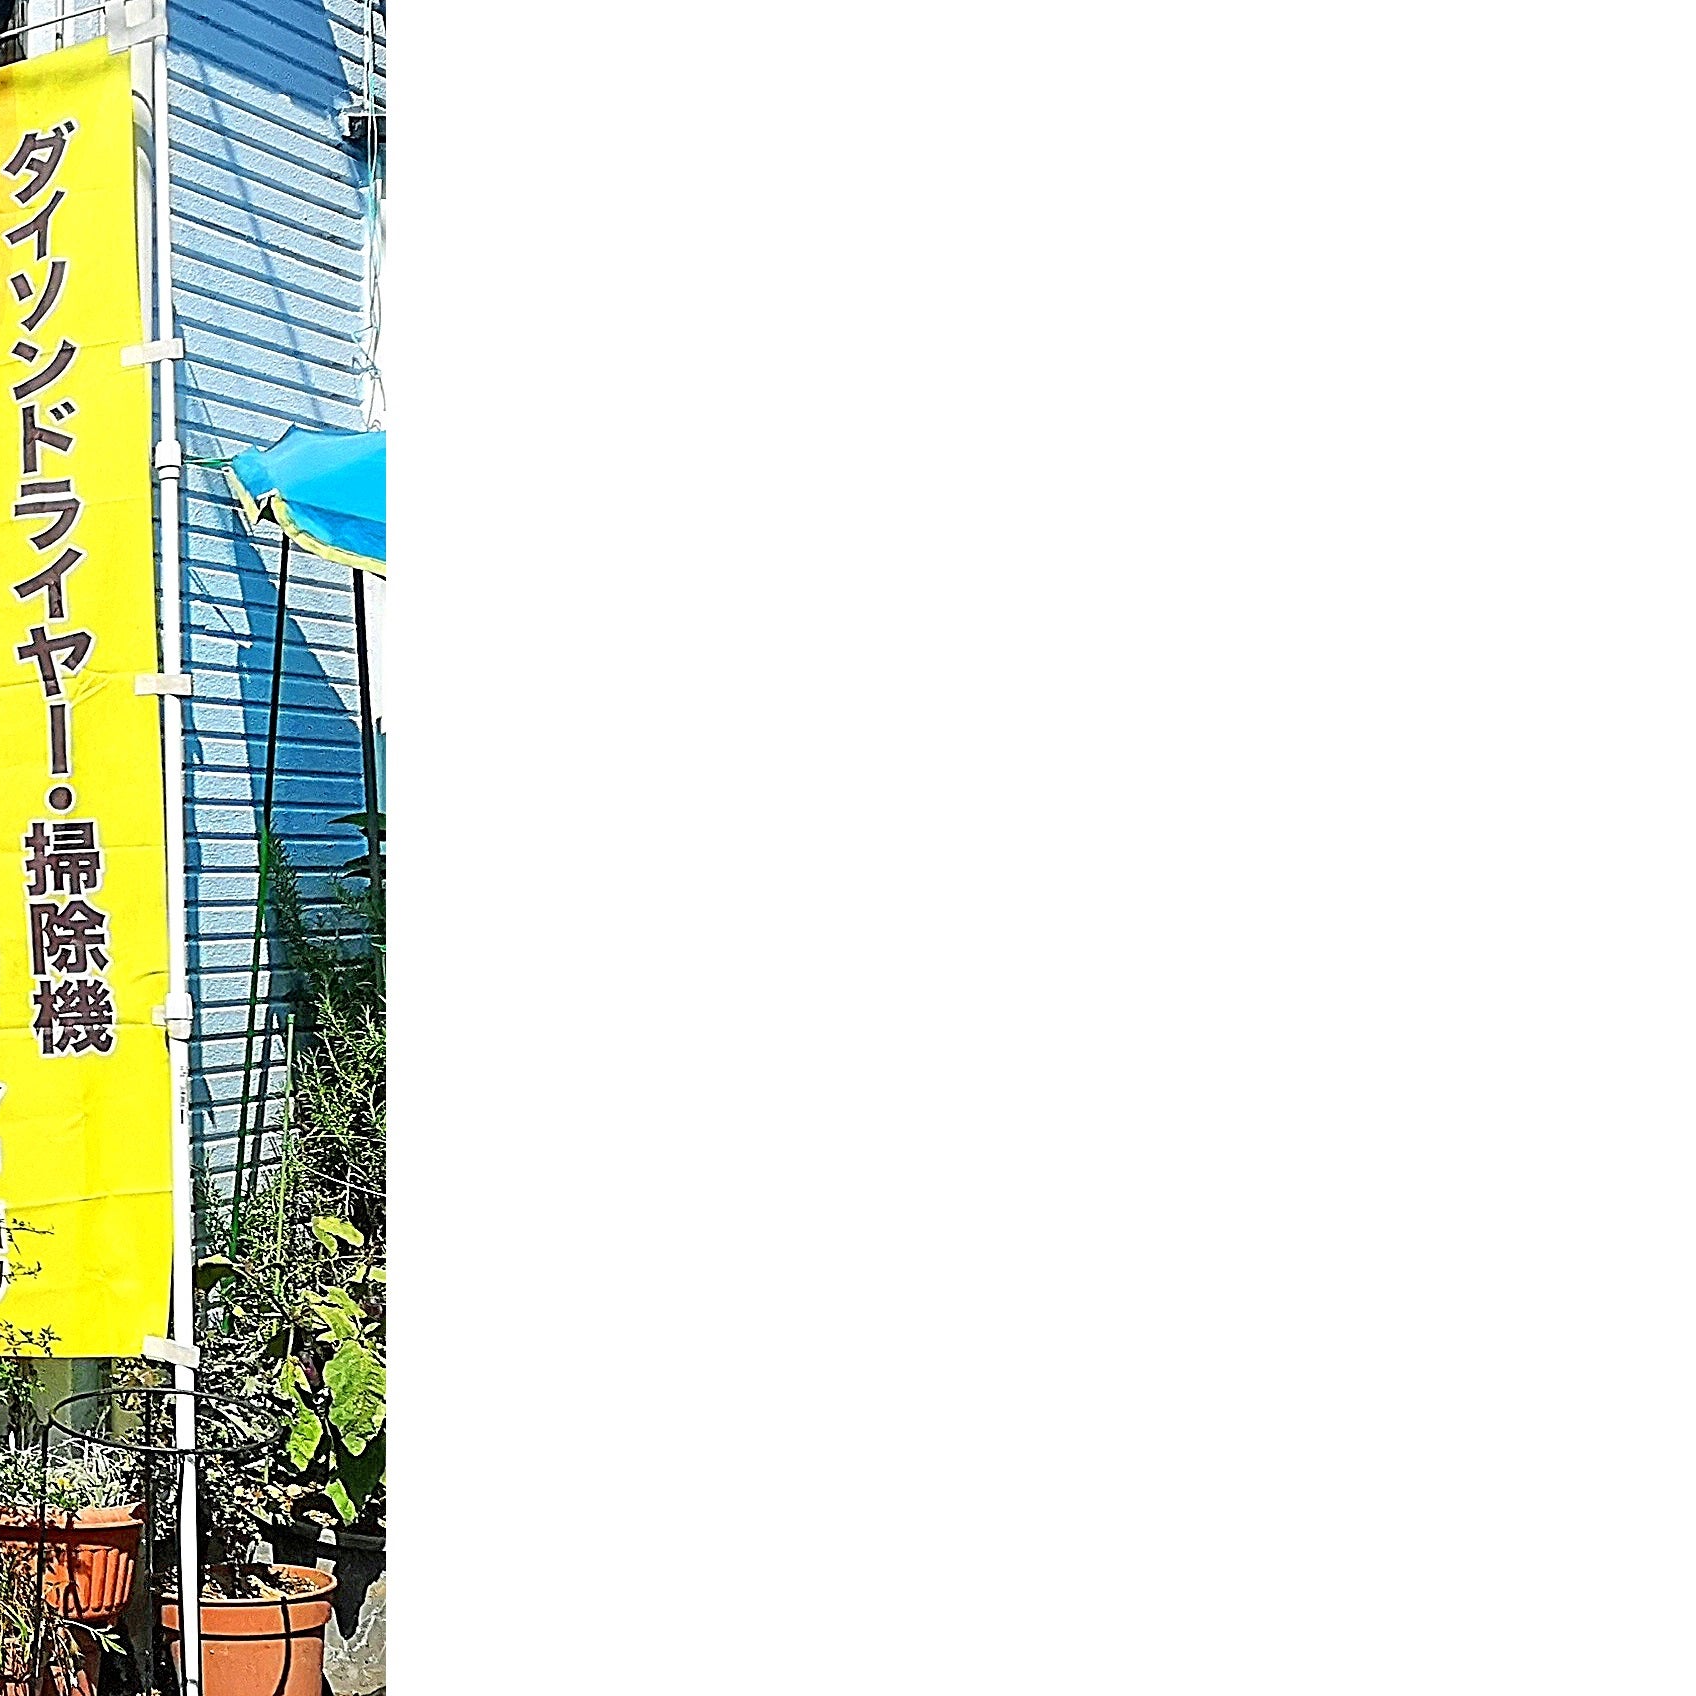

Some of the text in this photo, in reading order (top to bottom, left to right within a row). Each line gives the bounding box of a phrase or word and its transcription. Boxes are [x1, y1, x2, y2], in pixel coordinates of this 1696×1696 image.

[4, 119, 113, 1053] ダイソンドライヤー・掃除機
